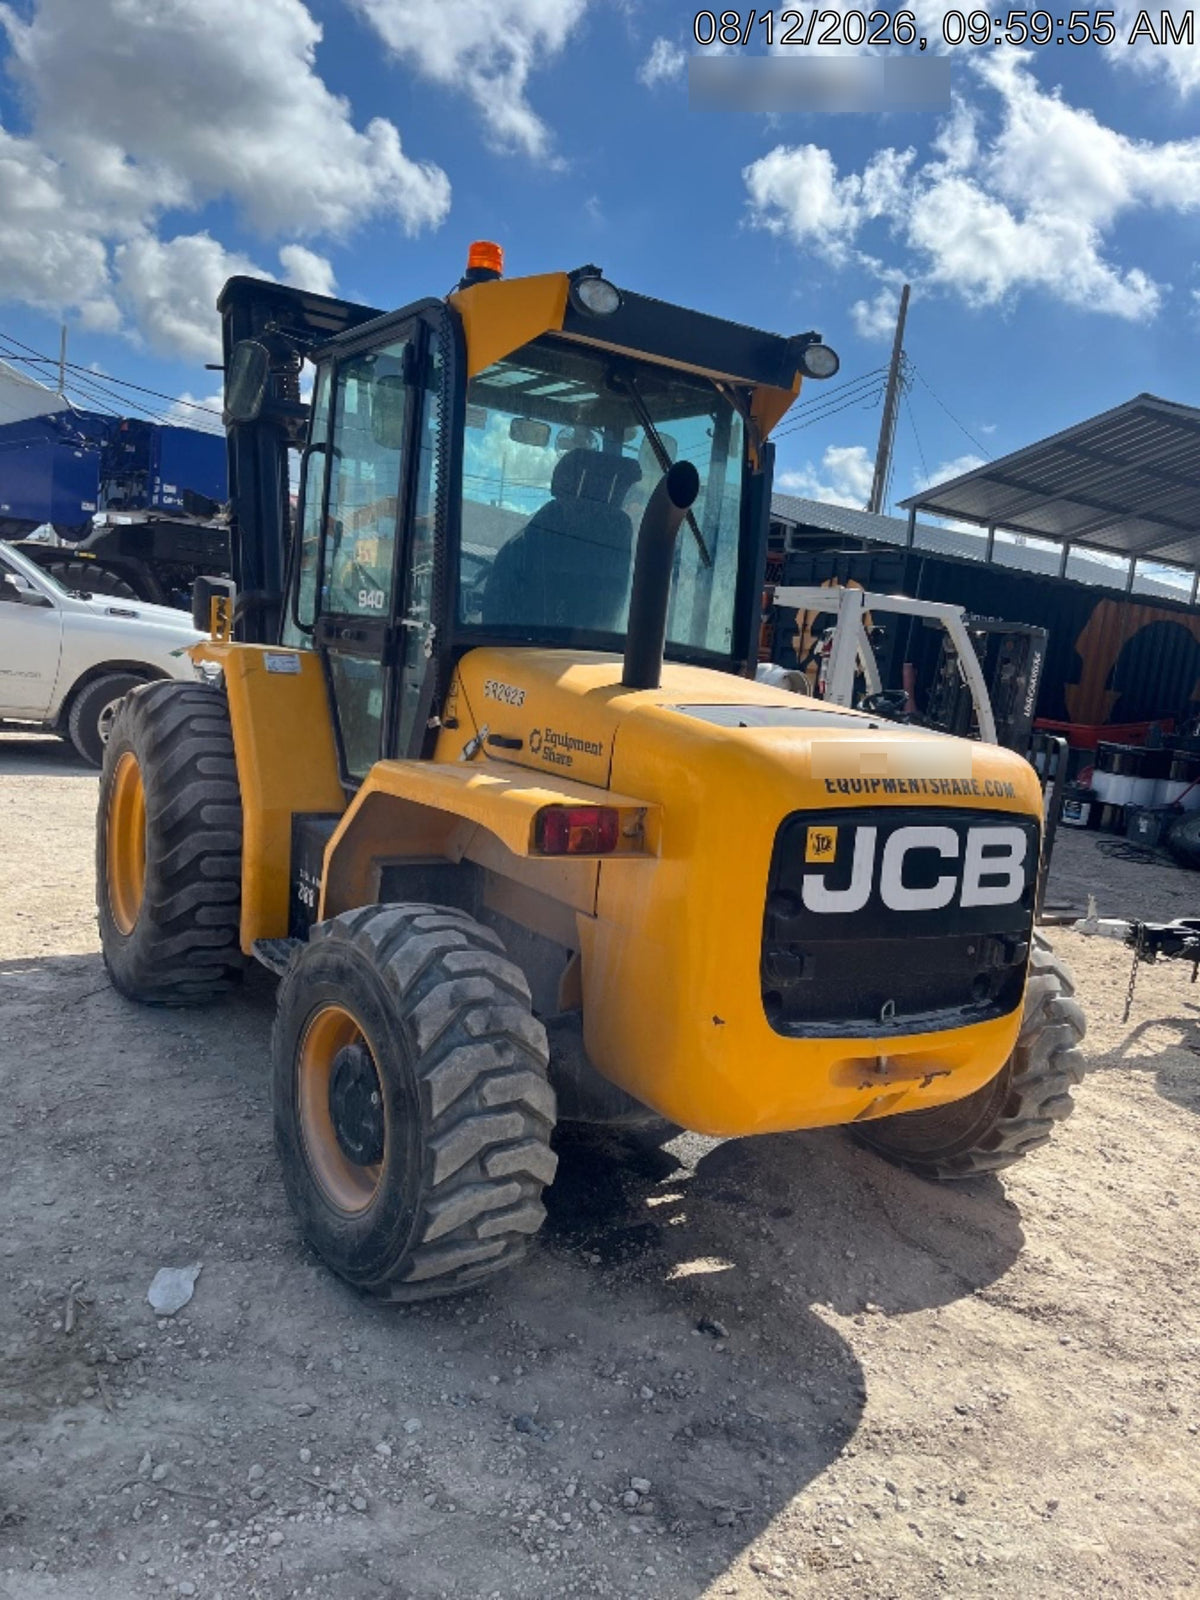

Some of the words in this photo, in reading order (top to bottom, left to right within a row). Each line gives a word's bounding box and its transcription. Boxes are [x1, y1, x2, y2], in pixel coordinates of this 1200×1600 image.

[358, 589, 385, 609] 940
[544, 729, 603, 757] Equipment
[542, 745, 573, 767] Share
[802, 826, 1027, 913] JCB
